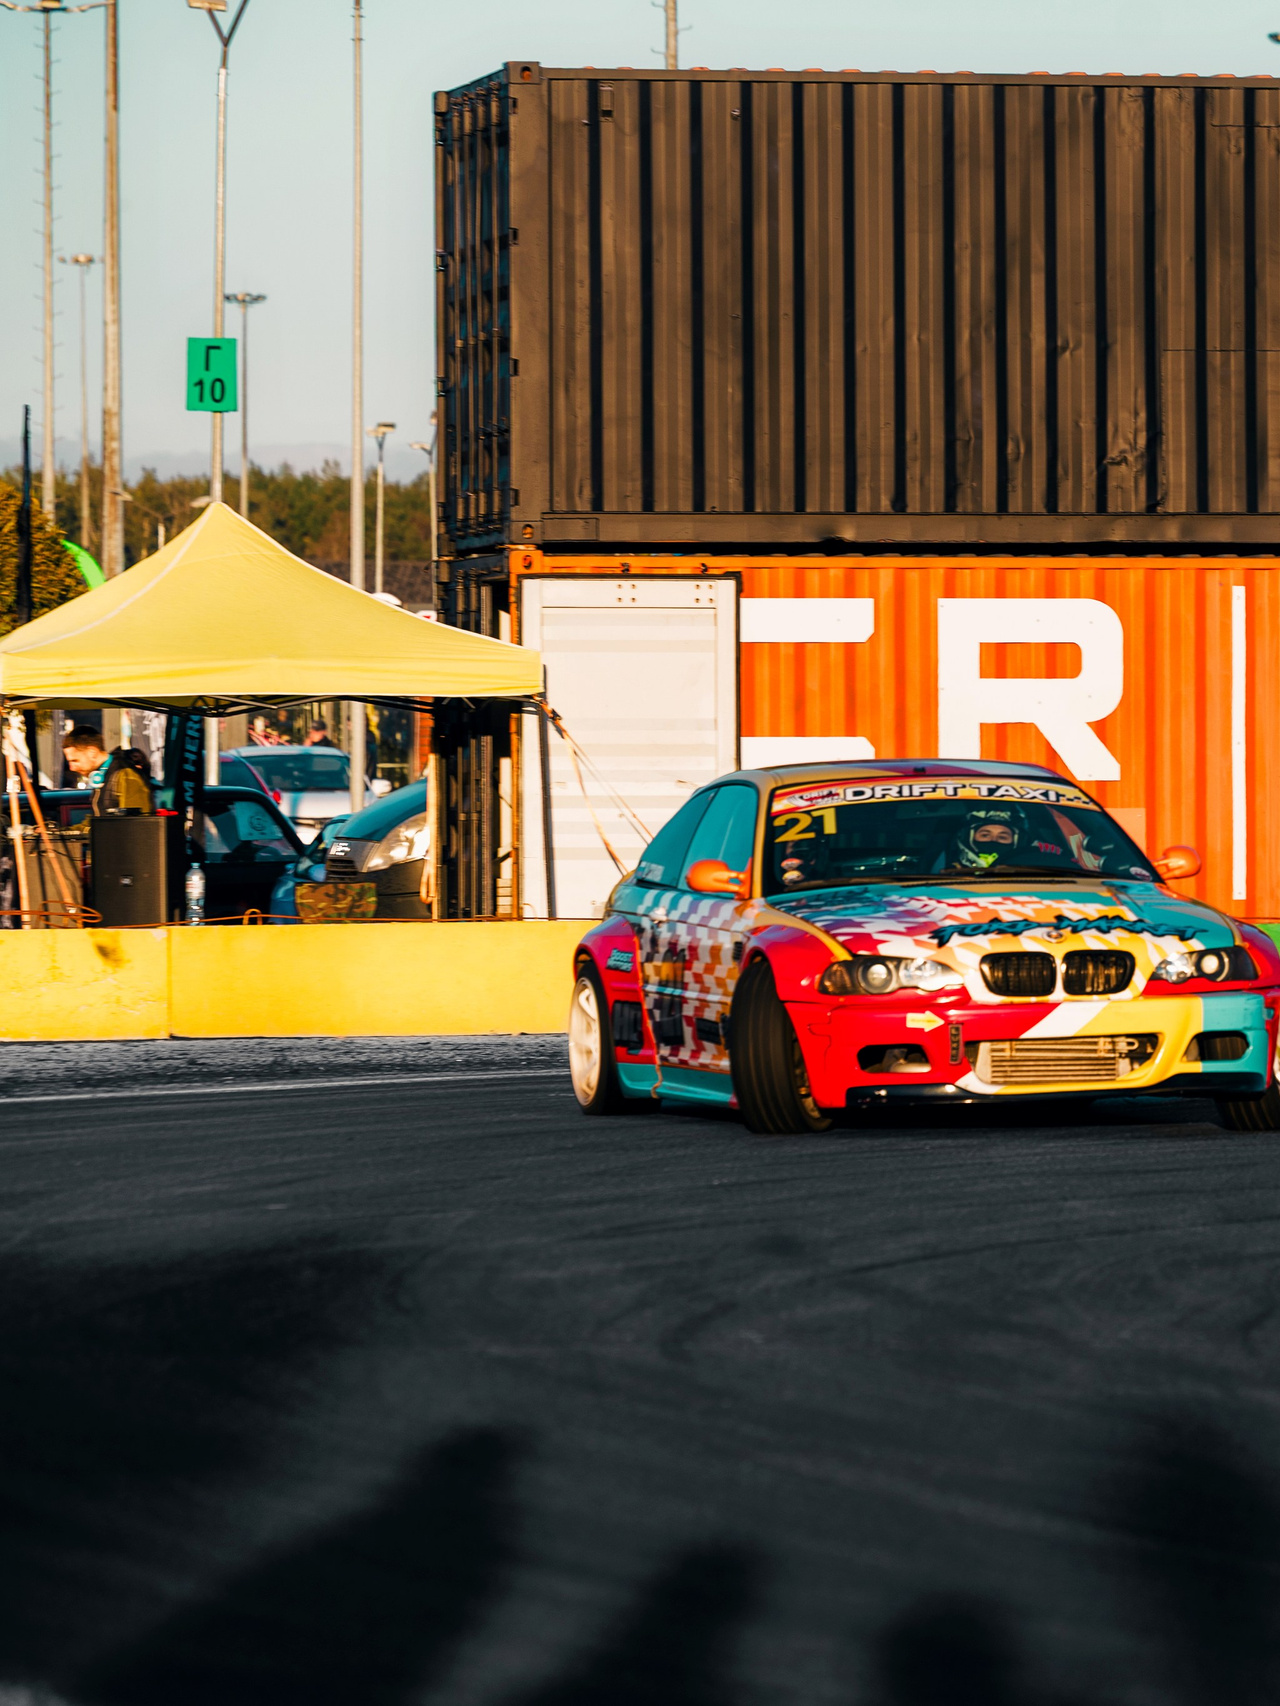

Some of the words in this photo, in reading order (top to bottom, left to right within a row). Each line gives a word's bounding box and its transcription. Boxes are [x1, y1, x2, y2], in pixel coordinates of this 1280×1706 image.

[204, 345, 221, 371] Г
[193, 378, 225, 404] 10
[844, 784, 967, 802] DRIFT
[970, 784, 1059, 802] TAXI
[773, 807, 837, 843] 21
